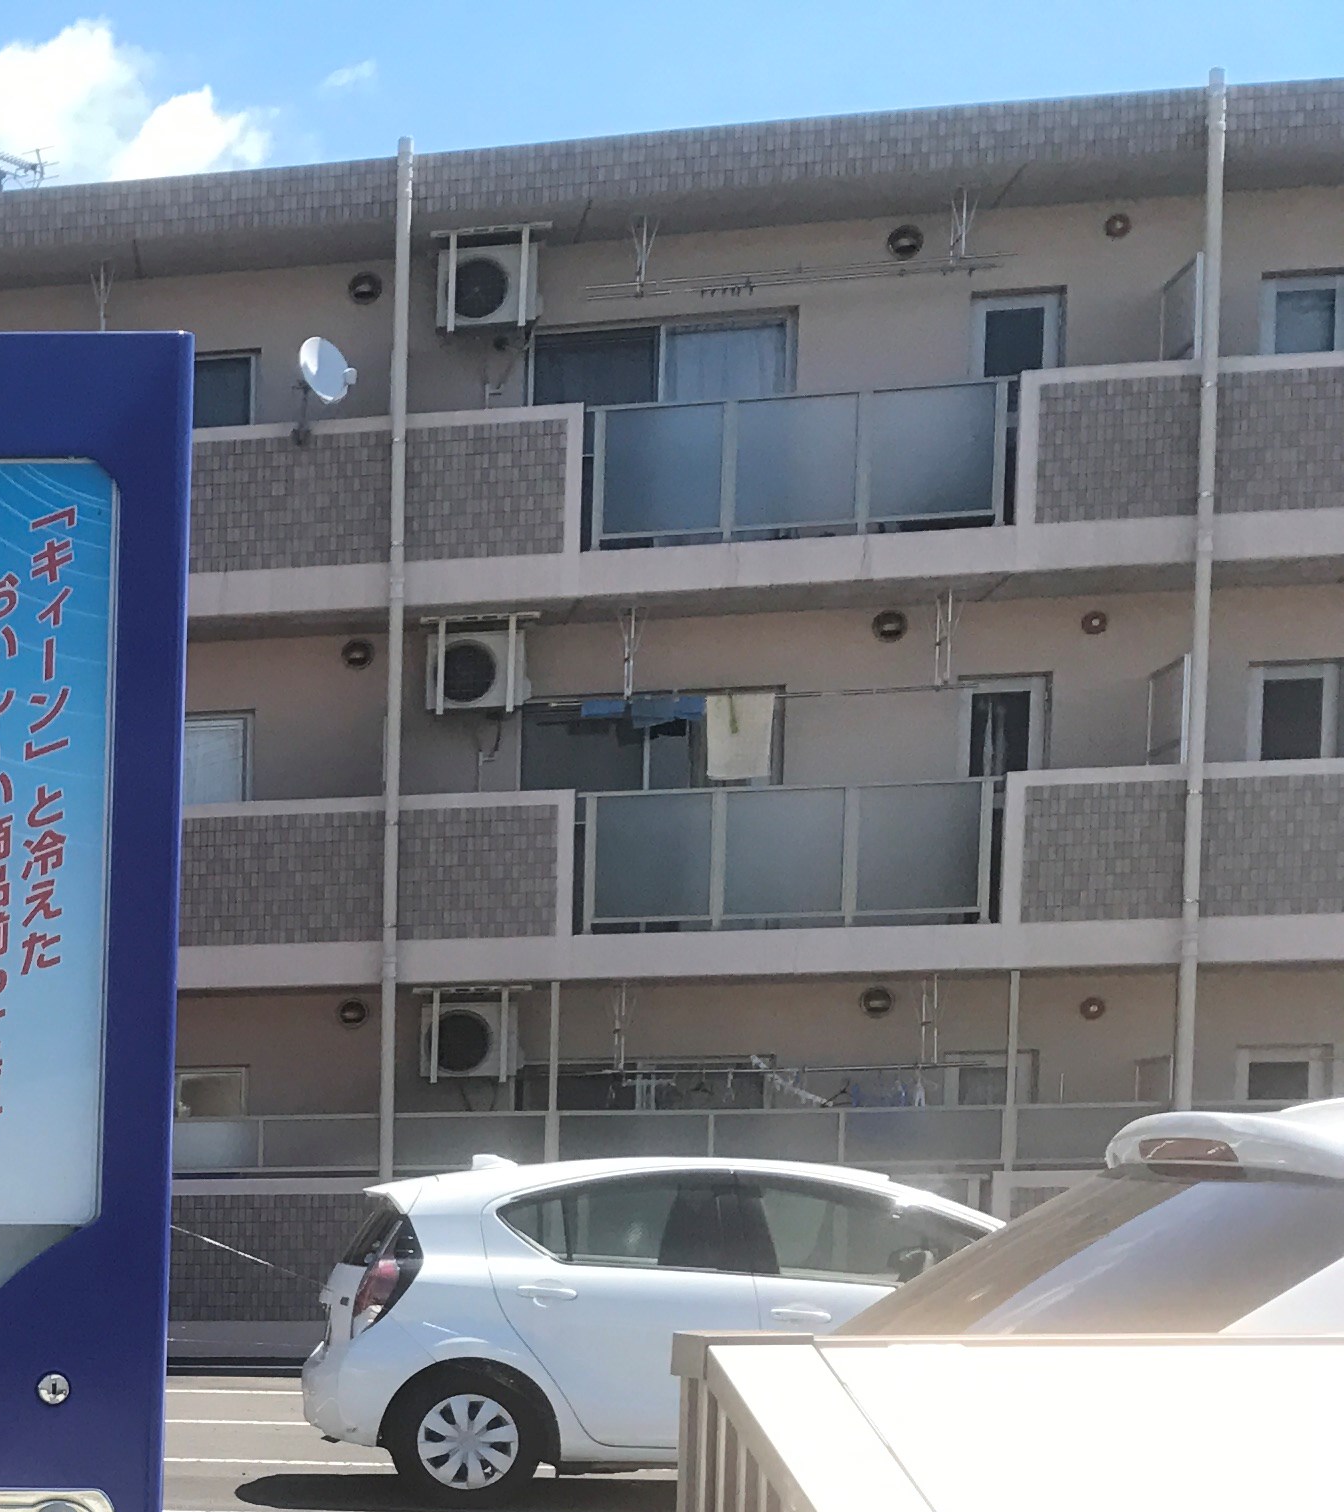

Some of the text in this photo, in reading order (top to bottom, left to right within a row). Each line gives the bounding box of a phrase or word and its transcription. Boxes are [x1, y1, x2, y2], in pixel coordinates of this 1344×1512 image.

[20, 505, 78, 976] 「キィーン」と冷えた
